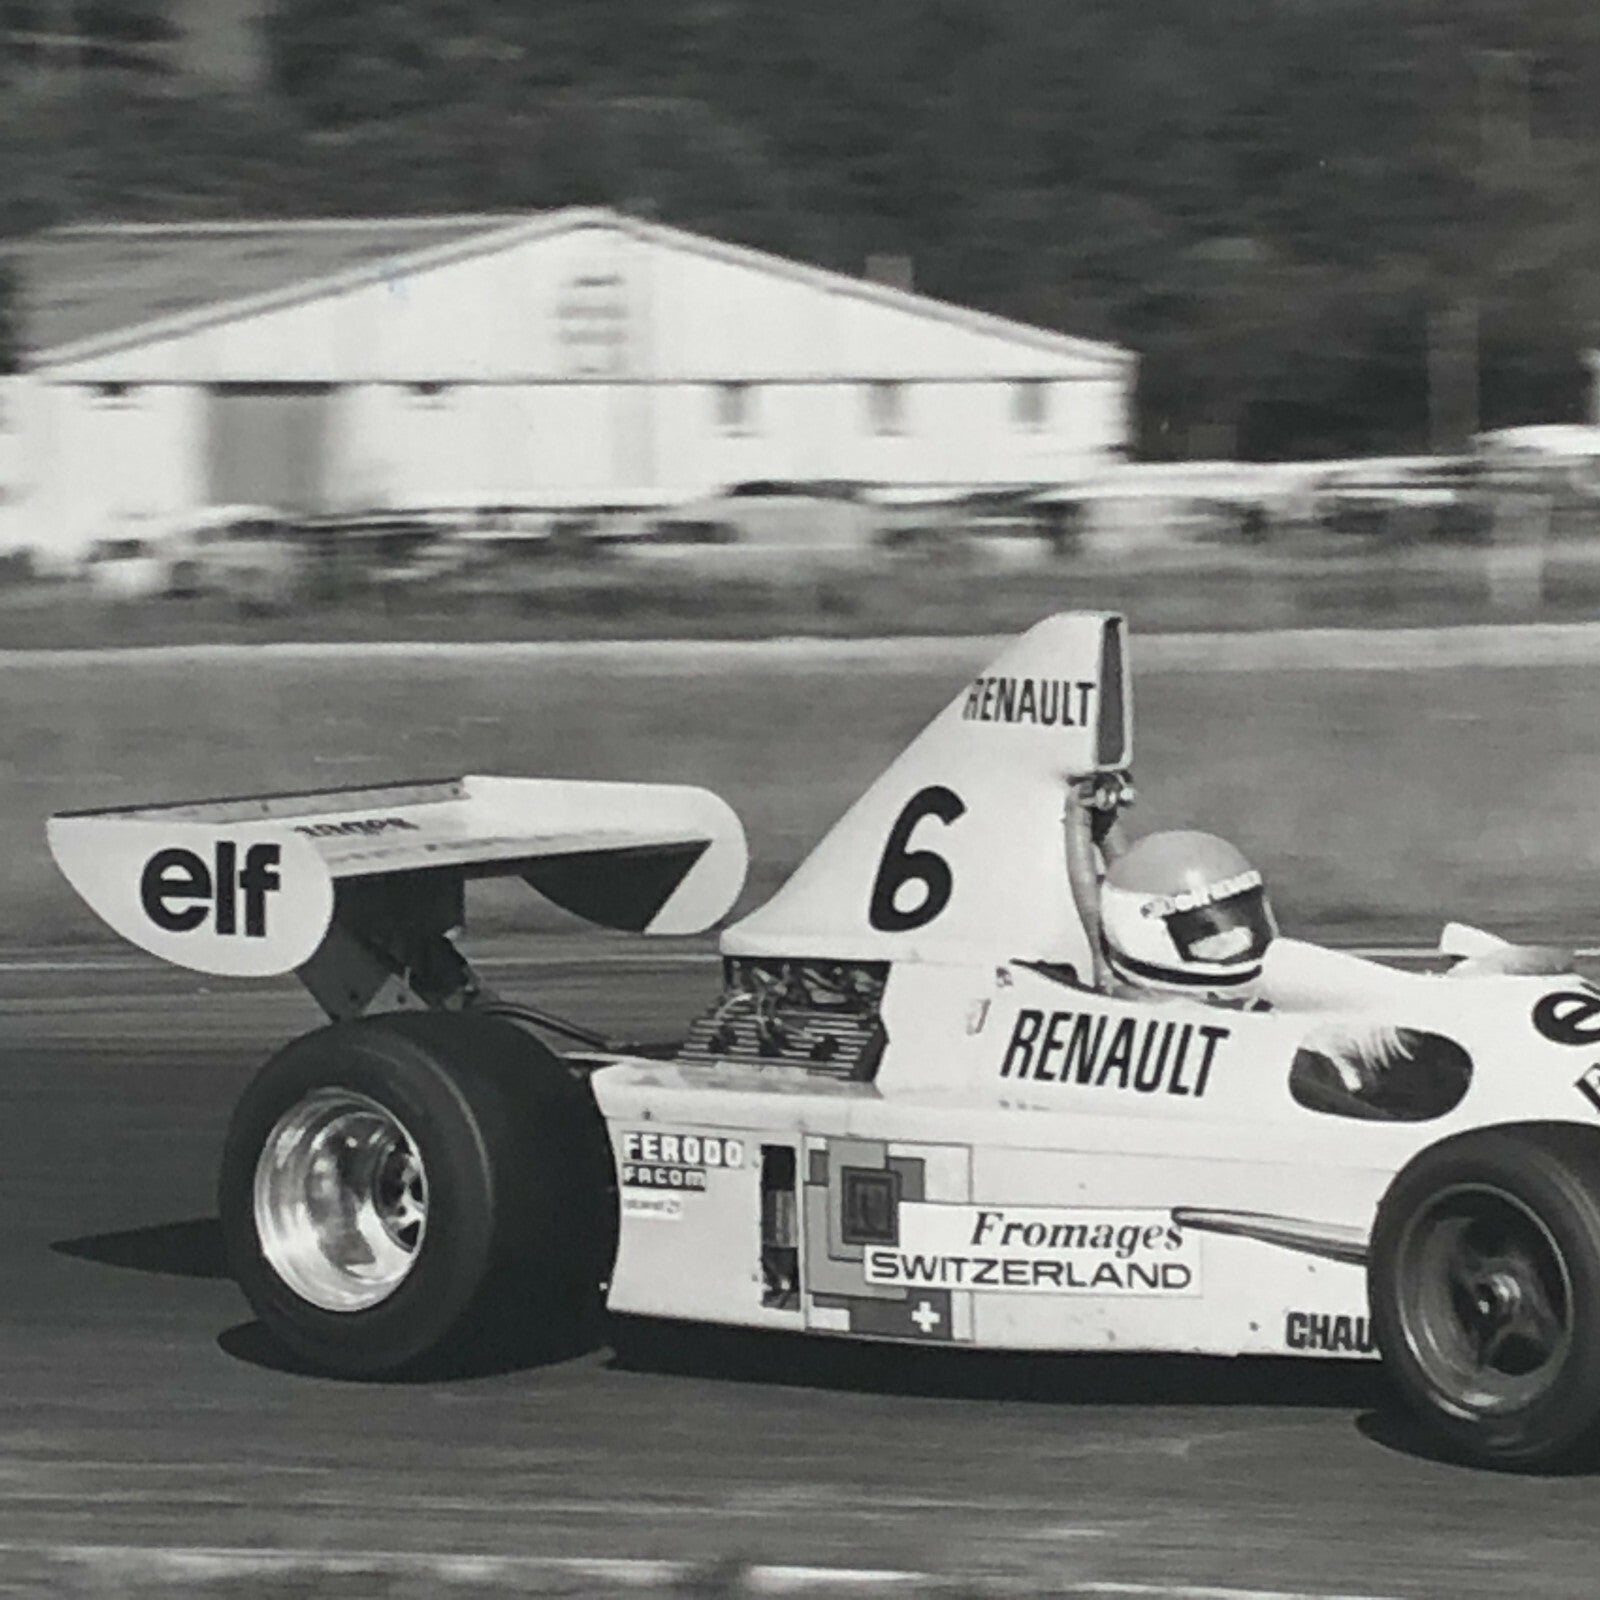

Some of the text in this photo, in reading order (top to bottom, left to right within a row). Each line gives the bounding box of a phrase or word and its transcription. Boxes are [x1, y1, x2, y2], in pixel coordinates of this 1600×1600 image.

[962, 677, 1095, 726] RENAULT
[869, 786, 967, 933] 6
[141, 841, 281, 937] elf
[1000, 1009, 1230, 1097] RENAULT
[622, 1132, 742, 1168] FERODO
[970, 1211, 1184, 1259] Fromages
[871, 1252, 1192, 1289] SWITZERLAND
